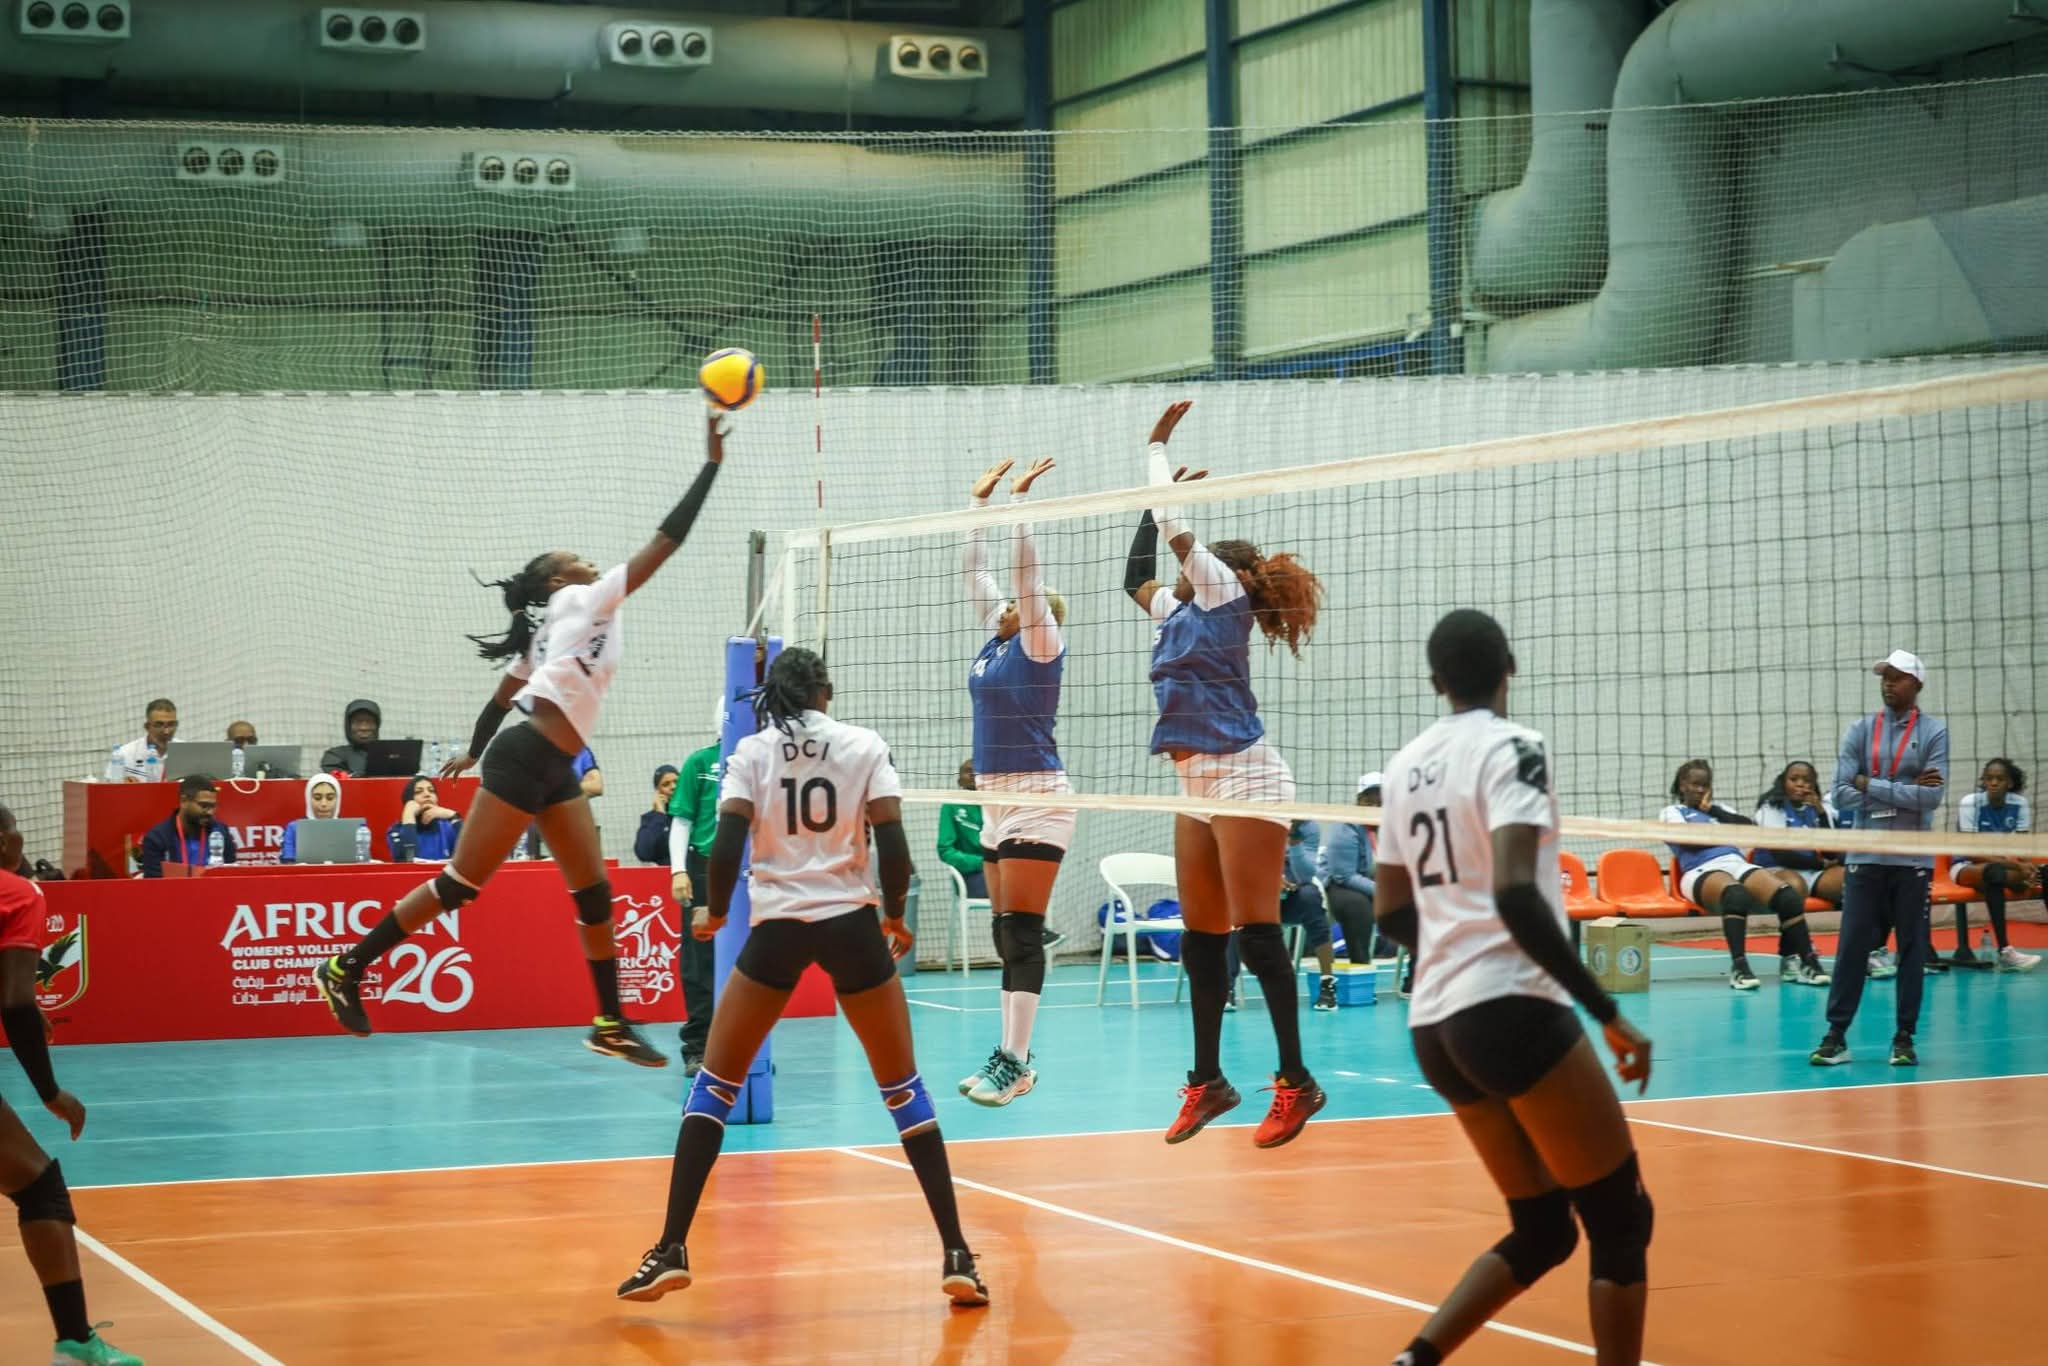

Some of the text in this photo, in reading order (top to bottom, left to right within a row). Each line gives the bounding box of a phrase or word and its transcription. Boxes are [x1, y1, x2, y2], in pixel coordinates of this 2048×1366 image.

[782, 739, 830, 762] DCI
[780, 777, 837, 836] 10
[1410, 807, 1459, 888] 21
[231, 945, 294, 957] WOMEN'S
[232, 959, 271, 970] CLUB
[383, 943, 474, 1013] 26
